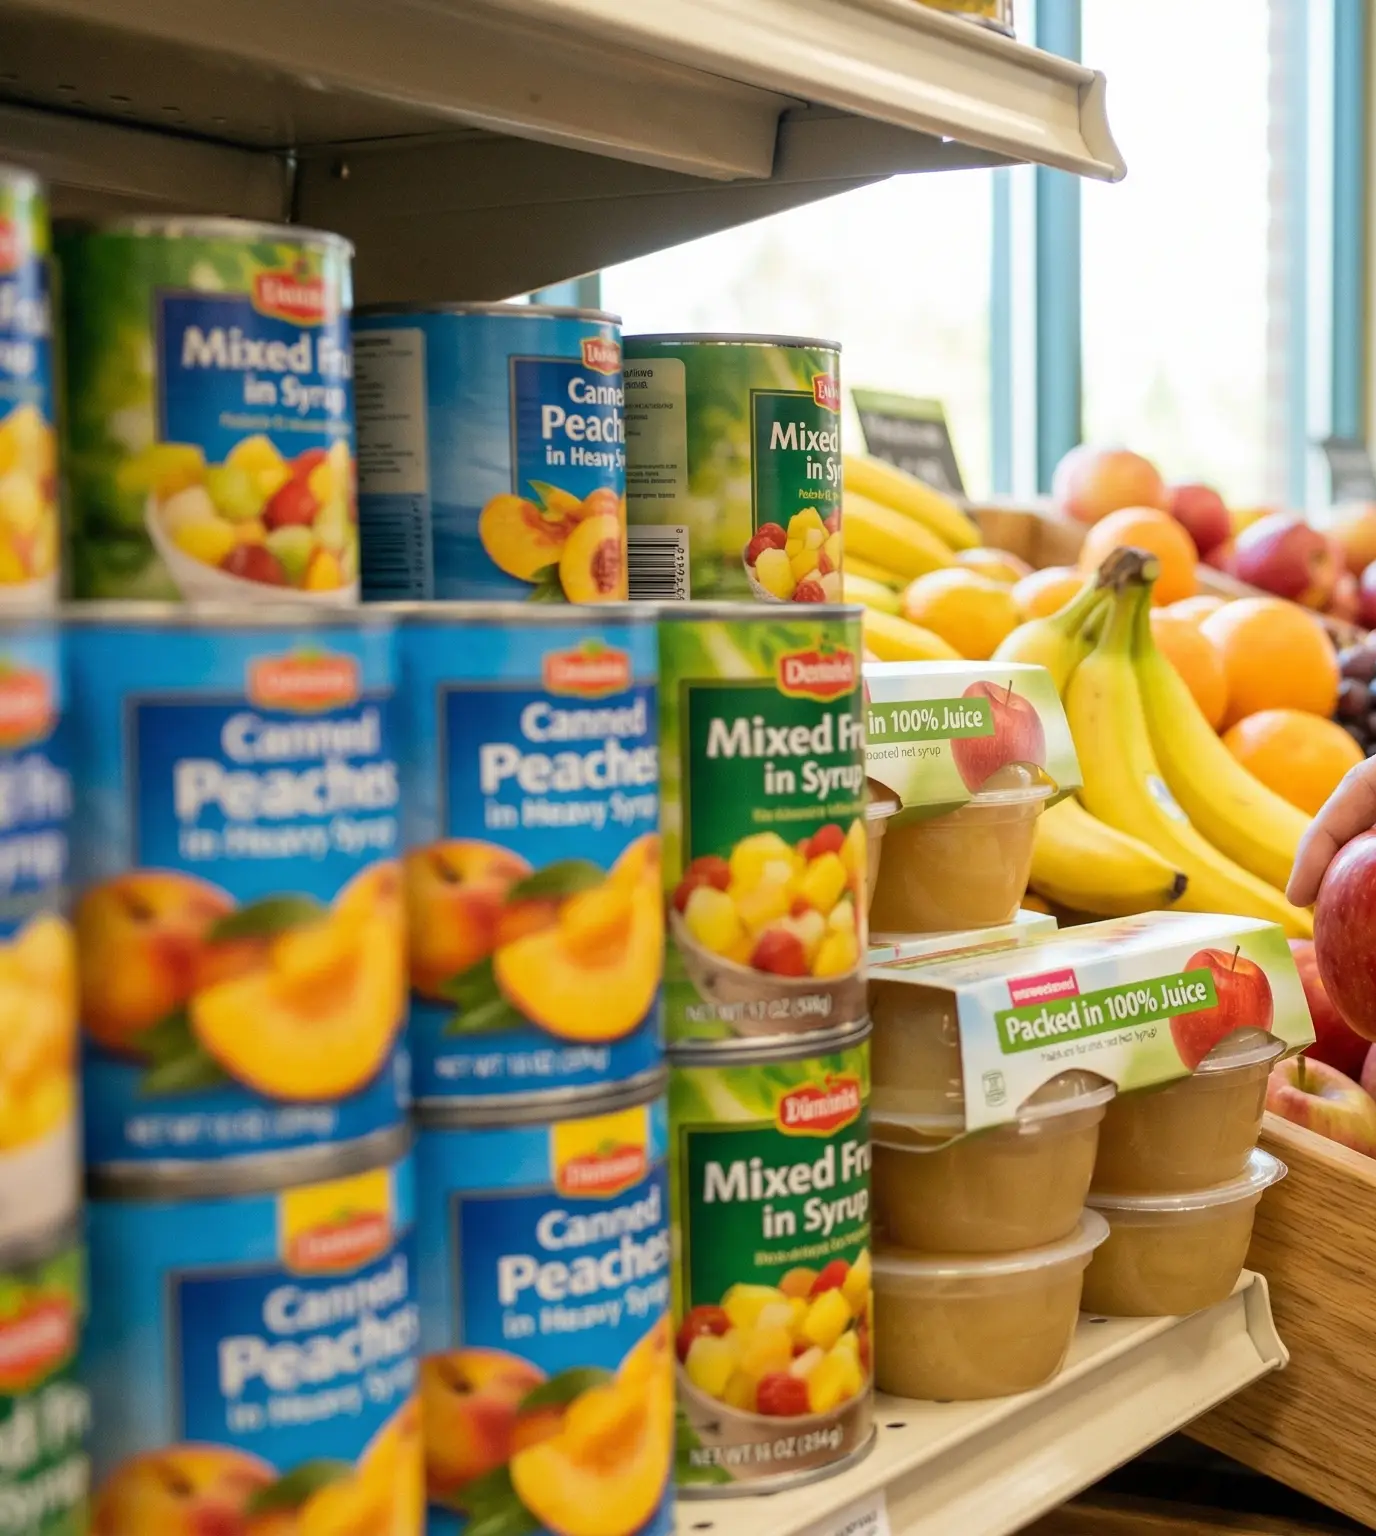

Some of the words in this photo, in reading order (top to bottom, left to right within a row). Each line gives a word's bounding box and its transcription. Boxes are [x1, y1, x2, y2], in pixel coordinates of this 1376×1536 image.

[182, 326, 312, 373] Mixed
[243, 373, 277, 405] in
[769, 421, 839, 453] Mixed
[545, 445, 566, 466] in
[570, 447, 615, 472] Heavy
[806, 455, 823, 480] in
[706, 712, 834, 760] Mixed
[867, 710, 886, 735] in
[890, 708, 939, 733] 100%
[941, 705, 983, 731] Juice
[763, 761, 796, 795] in
[801, 759, 863, 800] Syrup
[1005, 1001, 1082, 1045] Packed
[1081, 1000, 1104, 1027] in
[1104, 987, 1158, 1021] 100%
[1160, 979, 1207, 1010] Juice
[703, 1144, 836, 1204] Mixed
[762, 1204, 796, 1239] in
[804, 1188, 869, 1237] Syrup
